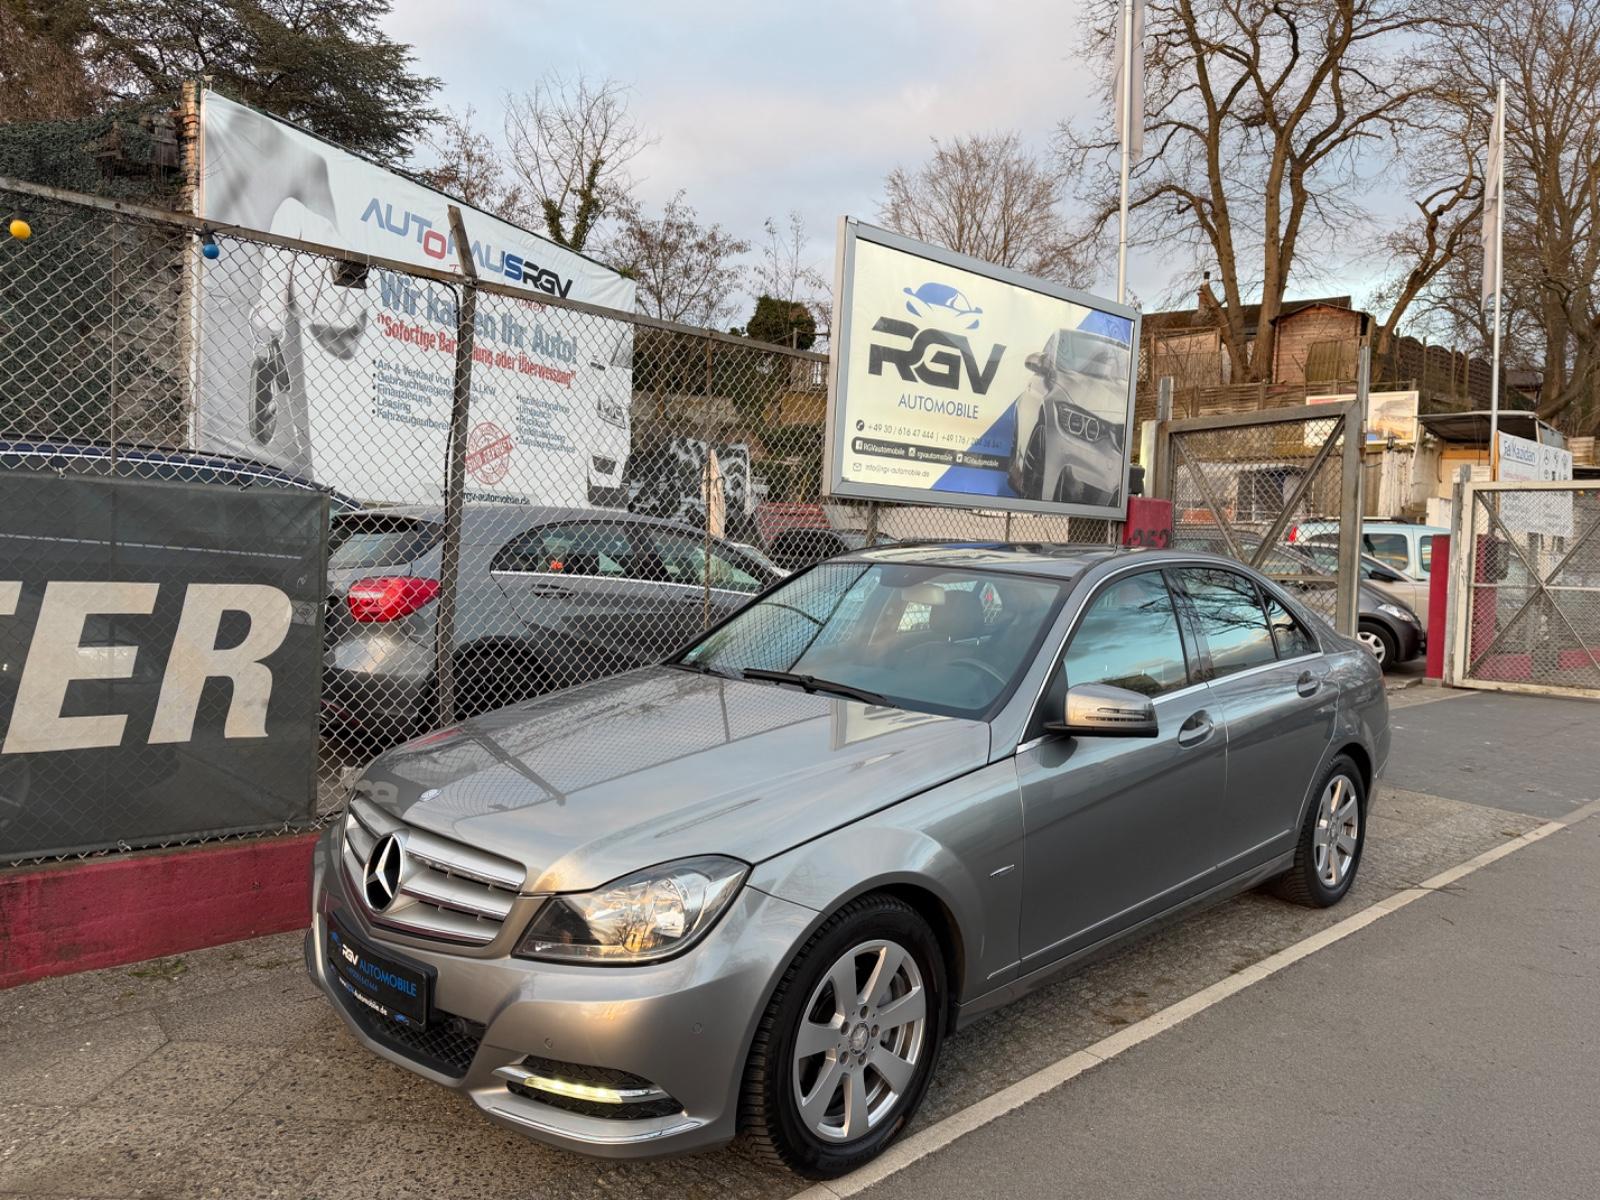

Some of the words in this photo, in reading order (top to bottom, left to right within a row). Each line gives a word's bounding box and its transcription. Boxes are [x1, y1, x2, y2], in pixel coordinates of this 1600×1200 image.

[379, 271, 421, 316] Wir
[501, 312, 528, 348] Ihr
[532, 324, 577, 364] Auto!
[495, 351, 514, 370] oder
[868, 316, 1007, 395] RGV
[435, 375, 451, 385] von
[377, 383, 432, 407] Finanzierung
[377, 396, 411, 414] Leasing
[898, 393, 979, 419] AUTOMOBILE
[898, 428, 911, 437] 616
[0, 580, 293, 754] ER
[342, 943, 359, 966] RGV
[360, 959, 417, 998] AUTOMOBILE
